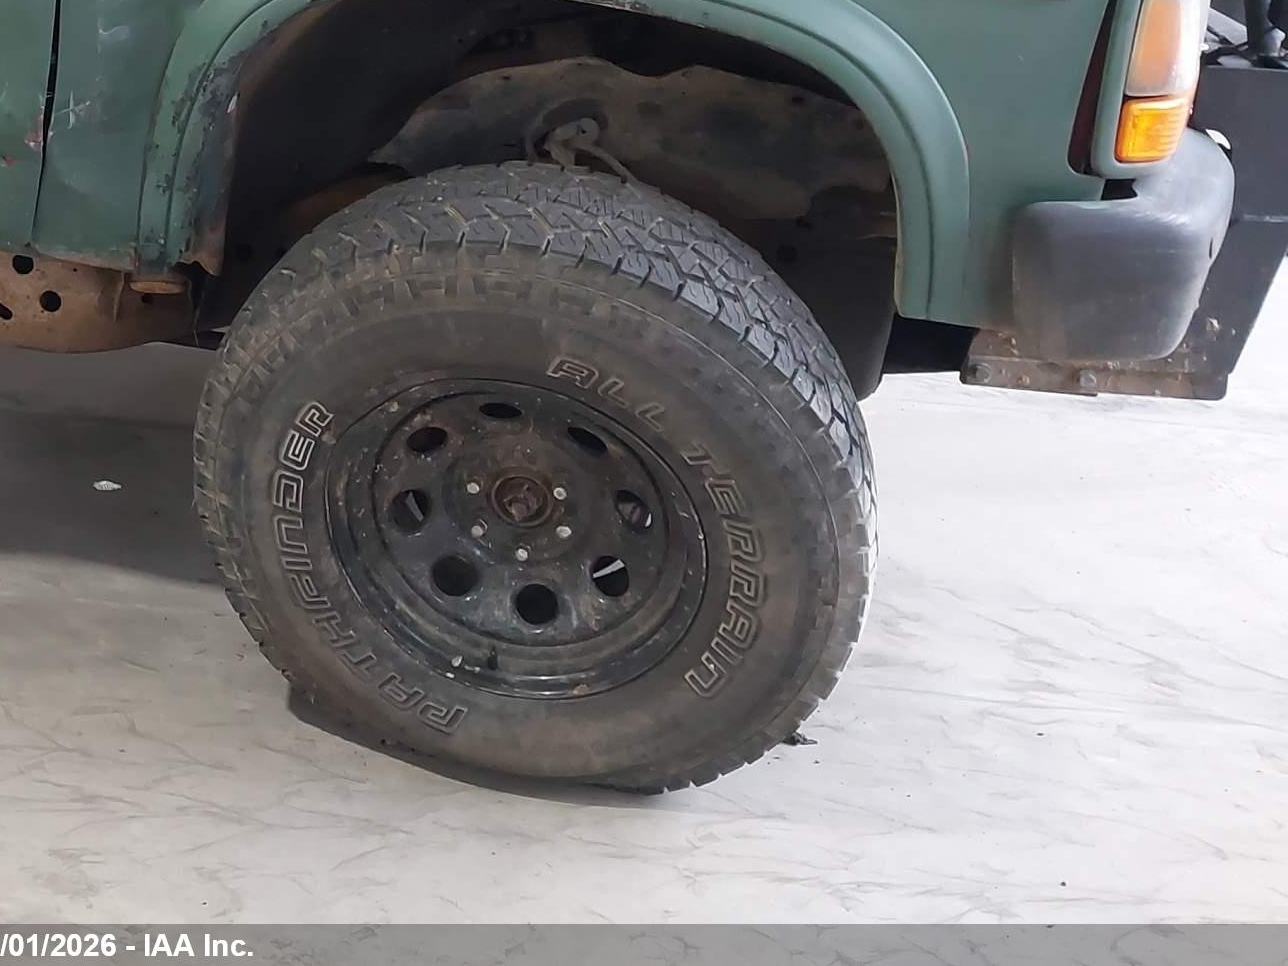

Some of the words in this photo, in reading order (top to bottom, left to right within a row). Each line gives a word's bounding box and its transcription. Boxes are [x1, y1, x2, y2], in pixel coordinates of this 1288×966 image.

[273, 401, 468, 734] PATHFINDER
[546, 355, 665, 433] ALL
[680, 442, 765, 698] TERRAIN
